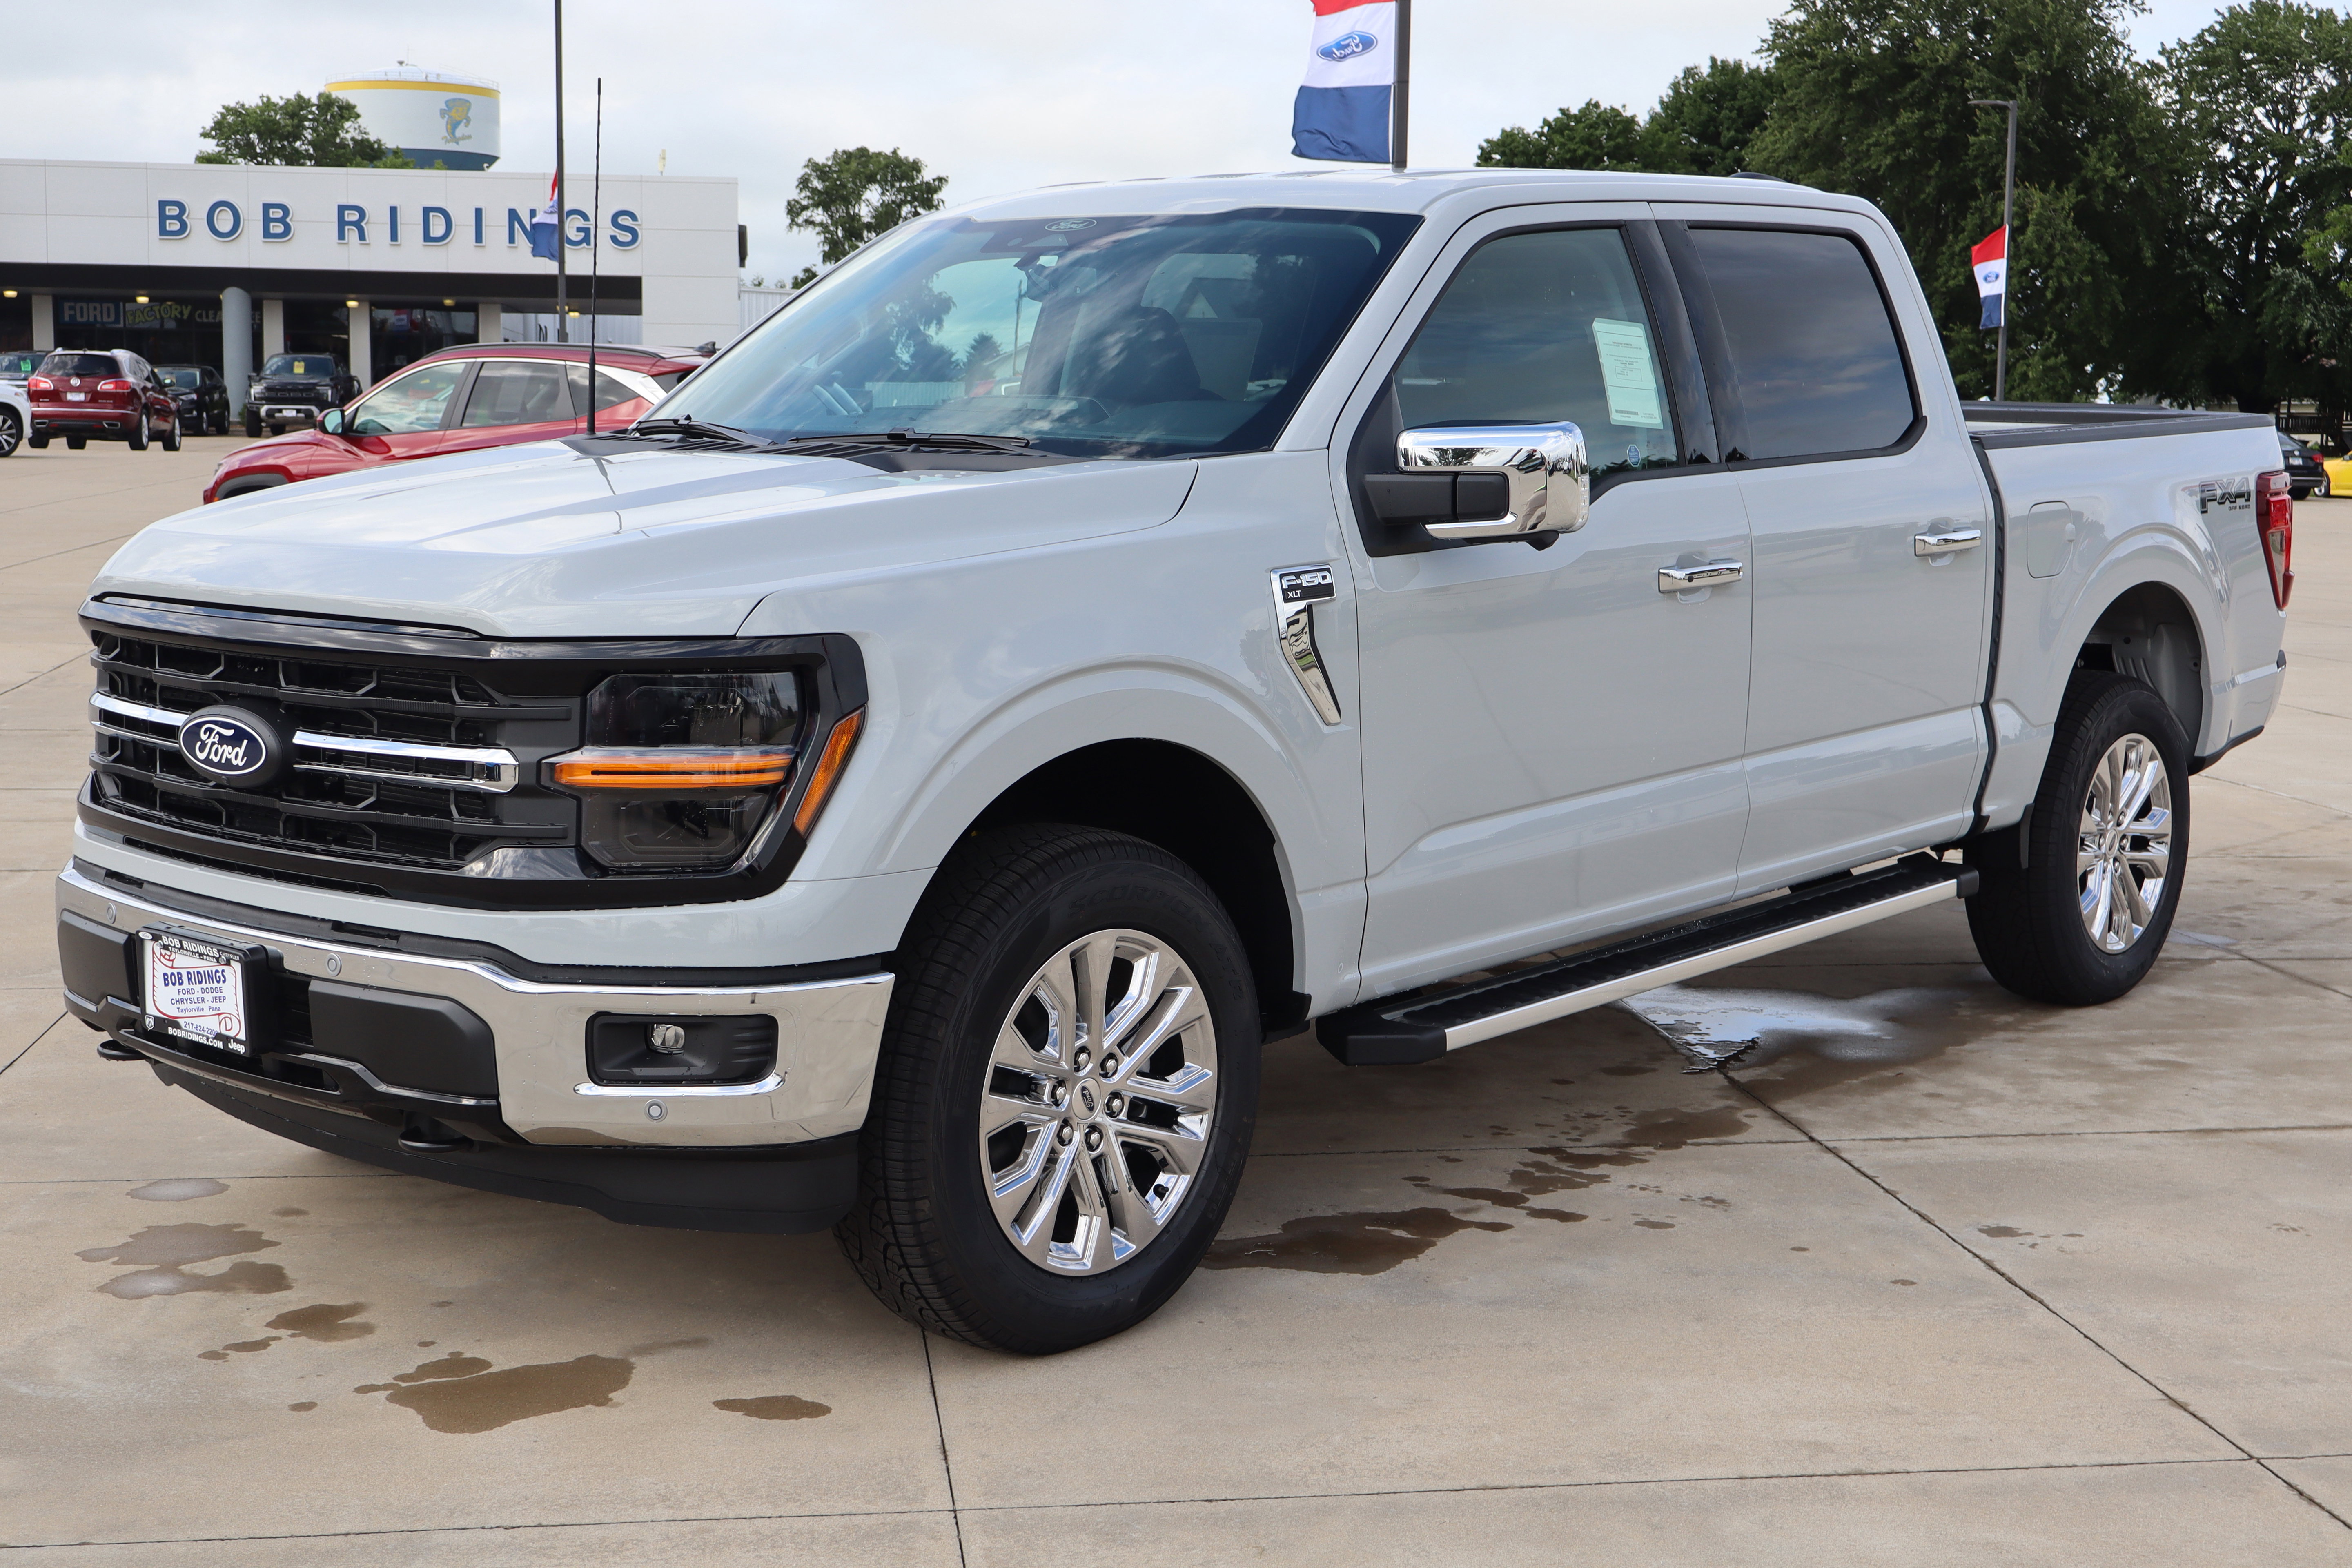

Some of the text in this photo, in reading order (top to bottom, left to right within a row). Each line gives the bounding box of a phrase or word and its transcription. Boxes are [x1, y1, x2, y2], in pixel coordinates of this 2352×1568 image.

[158, 198, 641, 249] BOB RIDINGS
[1051, 219, 1089, 229] Ford
[64, 302, 115, 322] FORD
[126, 305, 191, 324] FACTORY
[2199, 477, 2251, 514] FX4
[1282, 571, 1332, 589] F-150
[1287, 590, 1301, 599] XLT
[196, 723, 248, 766] Ford
[162, 935, 219, 958] BOB RIDINGS
[168, 946, 200, 959] TAYLORVILLE
[163, 969, 227, 987] BOB RIDINGS
[170, 997, 205, 1005] CHRYSLER
[168, 1027, 223, 1049] BOBRIDINGS.COM
[228, 1039, 245, 1054] Jeep
[1082, 1089, 1094, 1108] Ford
